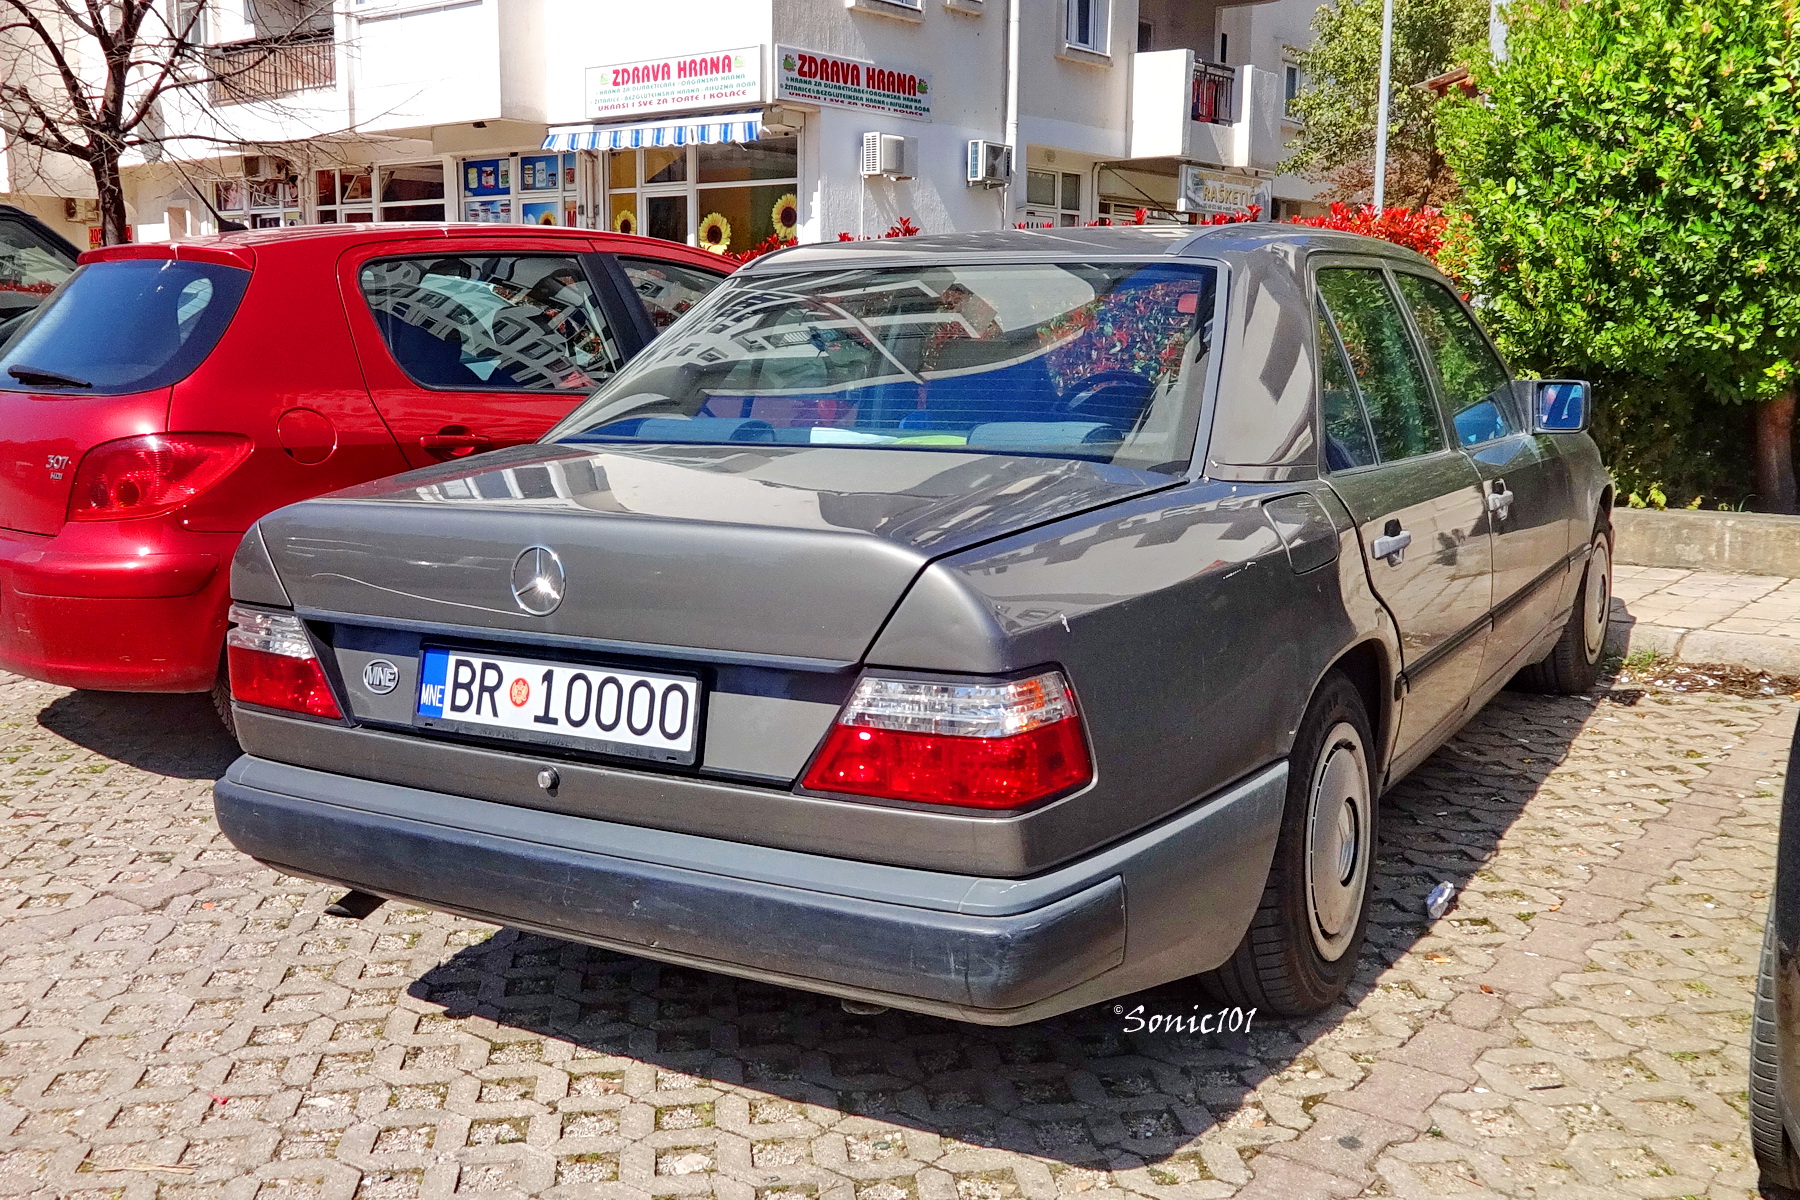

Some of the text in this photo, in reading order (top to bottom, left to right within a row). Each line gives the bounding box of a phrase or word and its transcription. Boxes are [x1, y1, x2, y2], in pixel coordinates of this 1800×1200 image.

[612, 54, 732, 87] ZDRAVA HRANA
[797, 53, 917, 97] ZDRAVA HRANA
[599, 88, 621, 96] HRANA
[680, 76, 719, 86] ORGANSKA
[720, 73, 745, 81] HRANA
[624, 90, 675, 101] BEZGLUTEINSKA
[676, 87, 700, 95] HRANA
[736, 80, 756, 88] ROBA
[788, 91, 821, 100] UKRASI
[790, 76, 812, 86] HRANA
[868, 90, 902, 101] ORGANSKA
[902, 95, 922, 105] HRANA
[598, 102, 629, 111] UKRASI
[637, 99, 653, 107] SVE
[671, 94, 700, 103] TORTE
[815, 89, 864, 103] BEZGLUTEINSKA
[865, 97, 885, 106] HRANA
[914, 105, 930, 113] ROBA
[45, 455, 69, 470] 307
[365, 664, 397, 687] MNE
[421, 682, 444, 708] MNE
[450, 659, 689, 741] BR 10000
